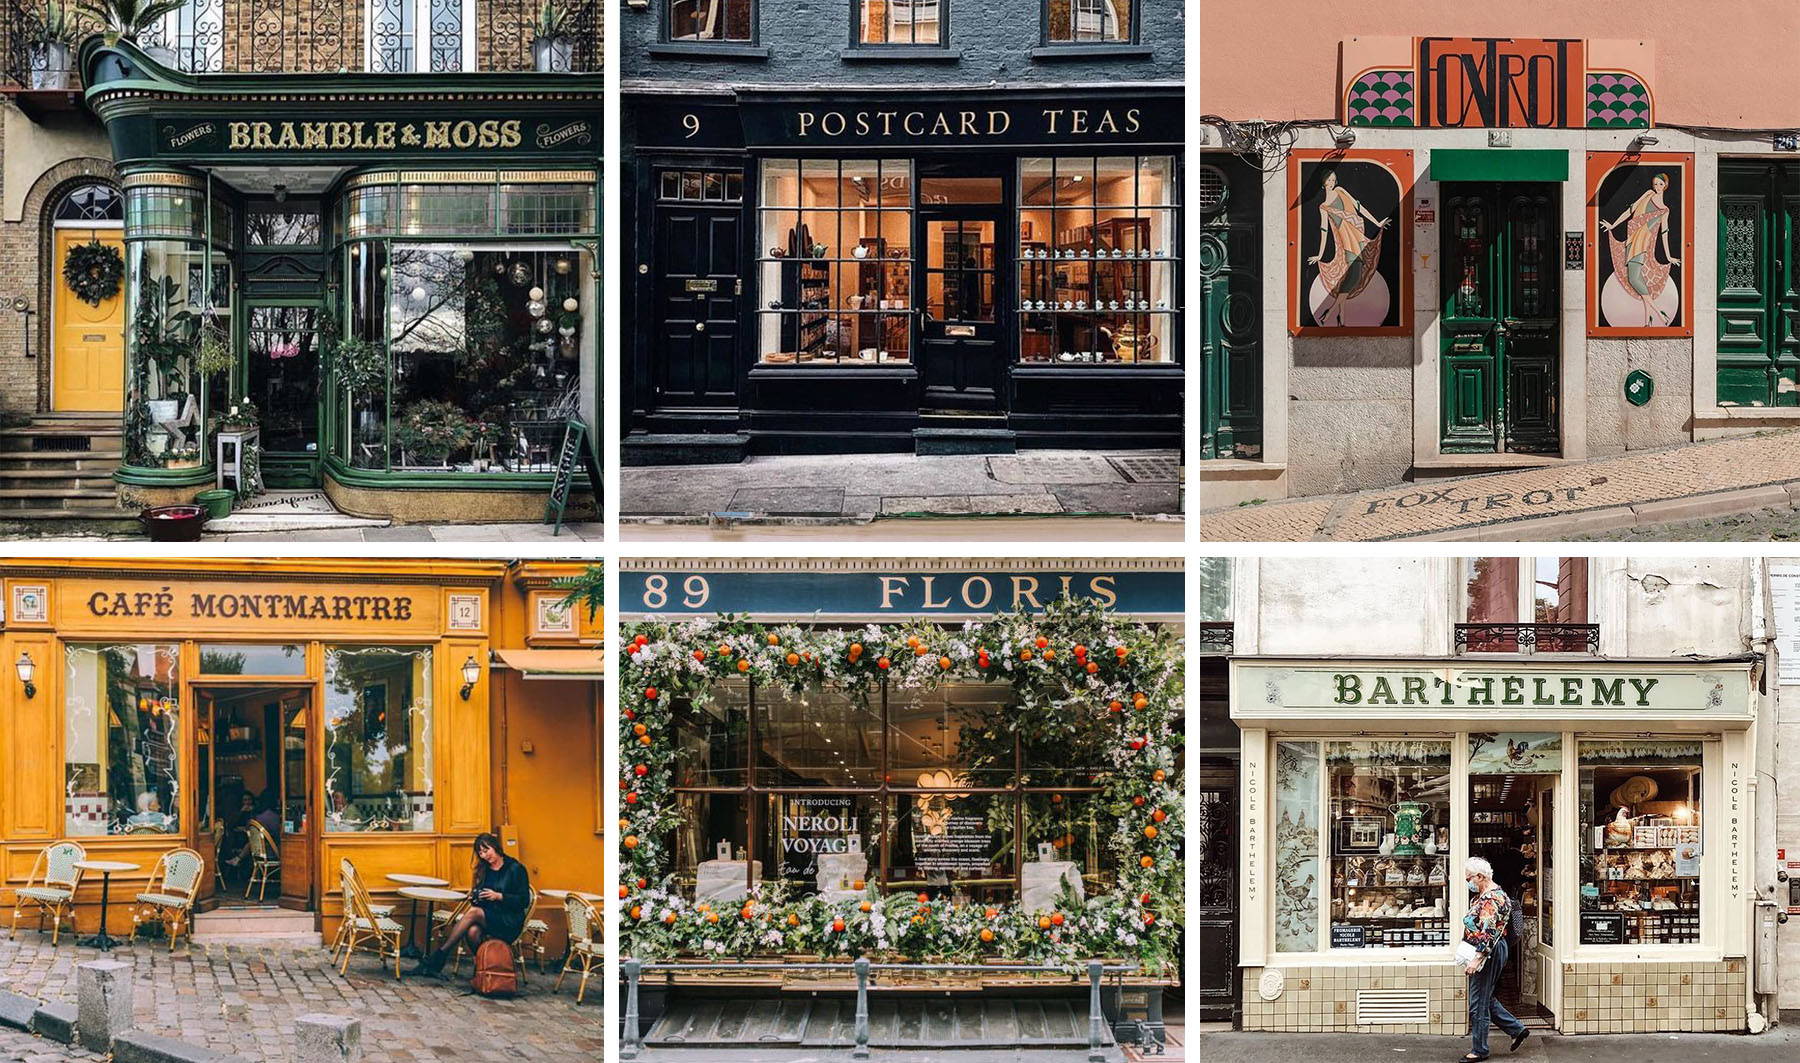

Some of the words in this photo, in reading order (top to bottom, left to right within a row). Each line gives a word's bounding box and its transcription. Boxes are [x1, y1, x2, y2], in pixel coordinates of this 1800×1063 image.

[1420, 37, 1581, 128] FOXTROT
[543, 122, 587, 146] FLOWERS
[683, 114, 700, 138] 9
[798, 111, 1011, 136] POSTCARD
[1042, 108, 1140, 134] TEAS
[170, 124, 212, 147] FLOWERS
[228, 120, 397, 149] BRAMBLE
[423, 120, 522, 149] MOSS
[642, 574, 710, 608] 89
[878, 575, 1117, 608] FLORIS
[87, 586, 174, 617] CAFÉ
[191, 593, 412, 621] MONTMARTRE
[459, 607, 470, 618] 12
[783, 816, 858, 832] NEROLI
[781, 838, 847, 853] VOYAG
[802, 861, 816, 875] de
